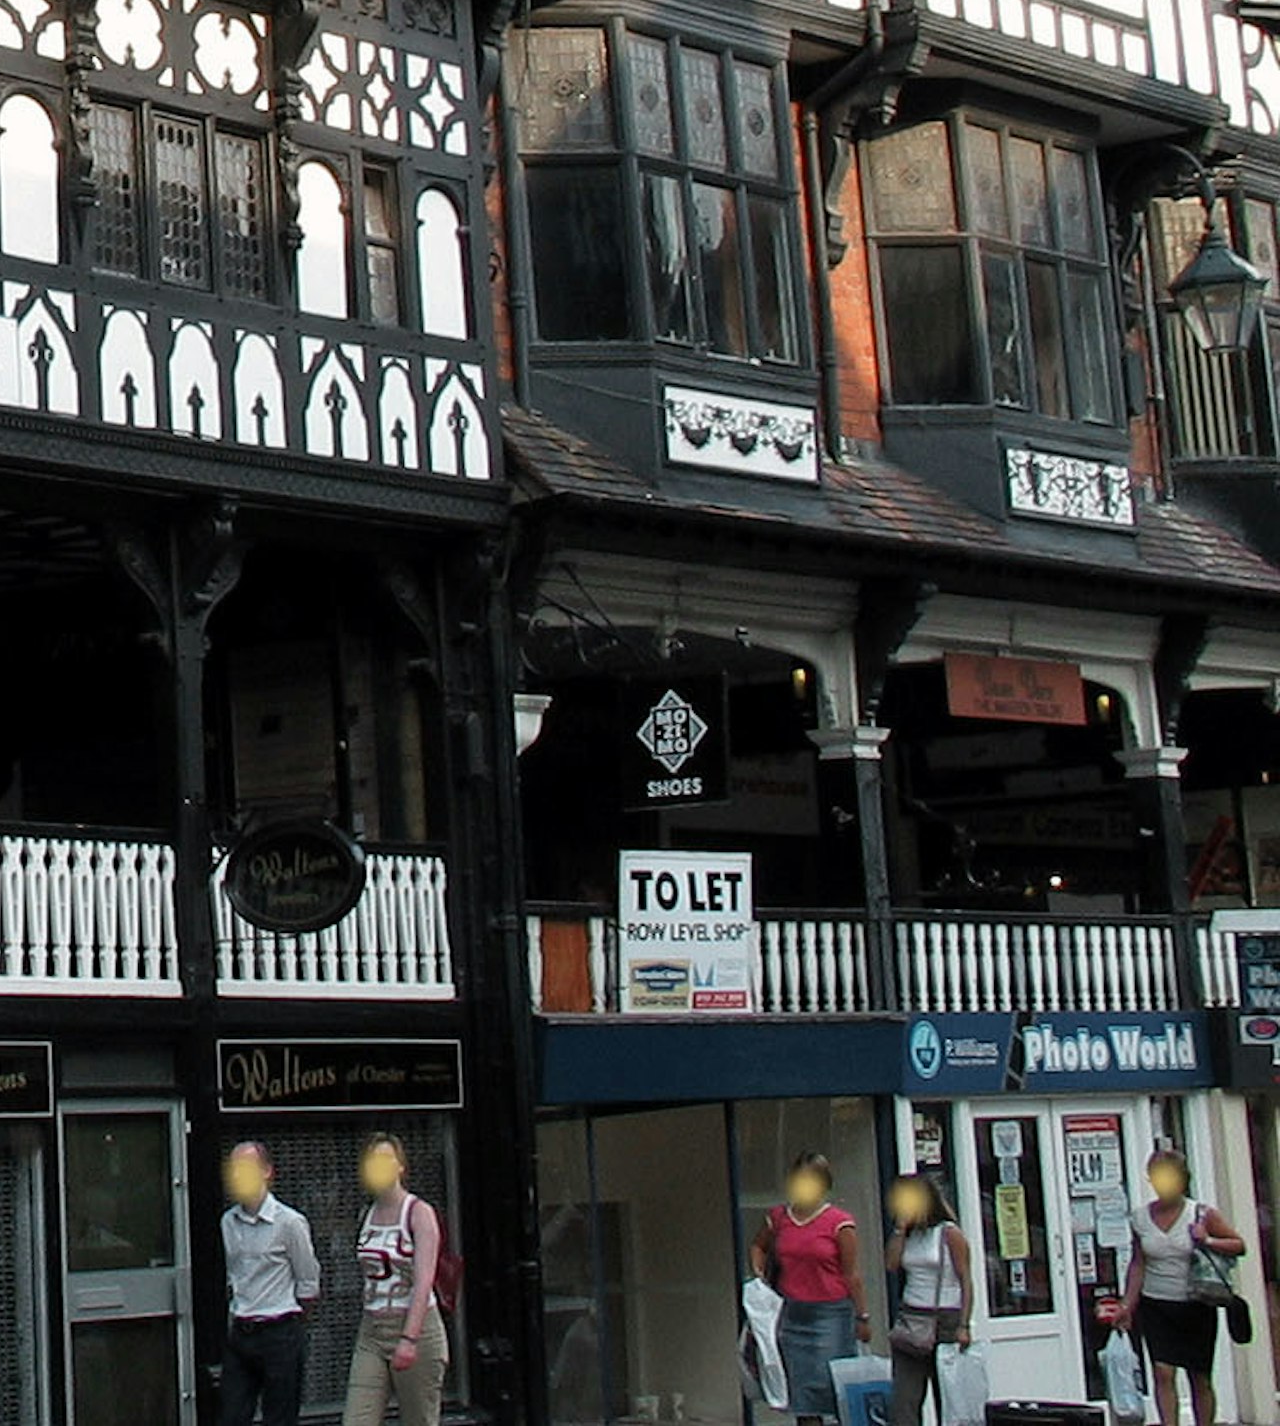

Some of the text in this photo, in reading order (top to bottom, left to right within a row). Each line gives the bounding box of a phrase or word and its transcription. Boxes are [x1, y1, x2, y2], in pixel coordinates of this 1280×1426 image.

[655, 708, 687, 726] MO
[657, 737, 688, 754] MO
[647, 777, 702, 797] SHOES
[630, 870, 743, 911] TO LET
[627, 923, 744, 942] ROW LEVEL SHOP
[1022, 1023, 1110, 1072] Photo
[1108, 1022, 1197, 1071] World
[226, 1047, 336, 1104] Waltons
